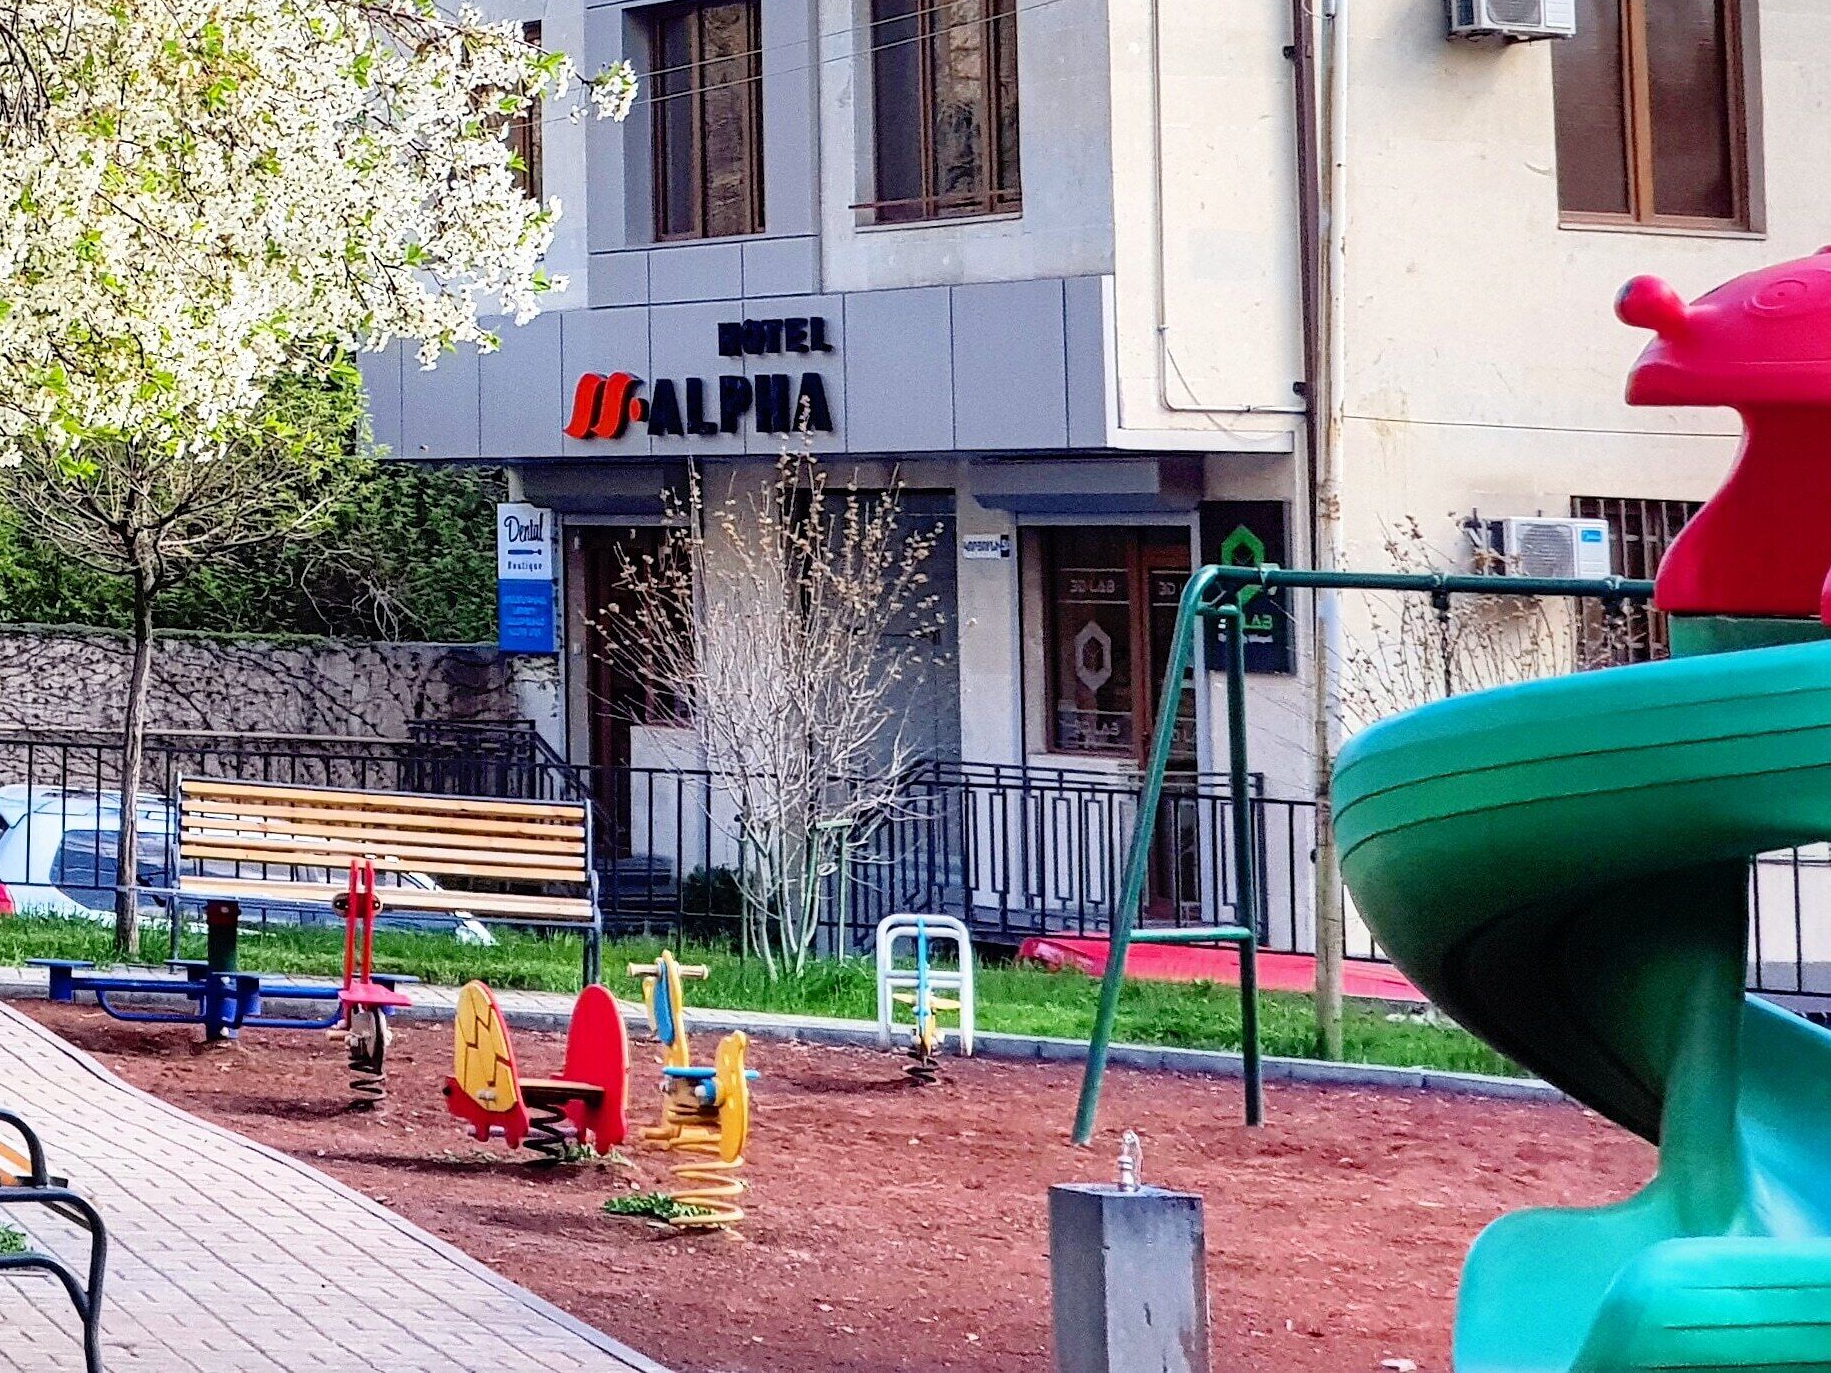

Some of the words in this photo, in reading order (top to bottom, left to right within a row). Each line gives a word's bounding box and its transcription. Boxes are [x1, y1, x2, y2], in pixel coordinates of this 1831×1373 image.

[718, 316, 832, 357] HOTEL
[648, 372, 833, 435] ALPHA
[504, 513, 544, 542] Dental
[508, 560, 542, 572] Boutique
